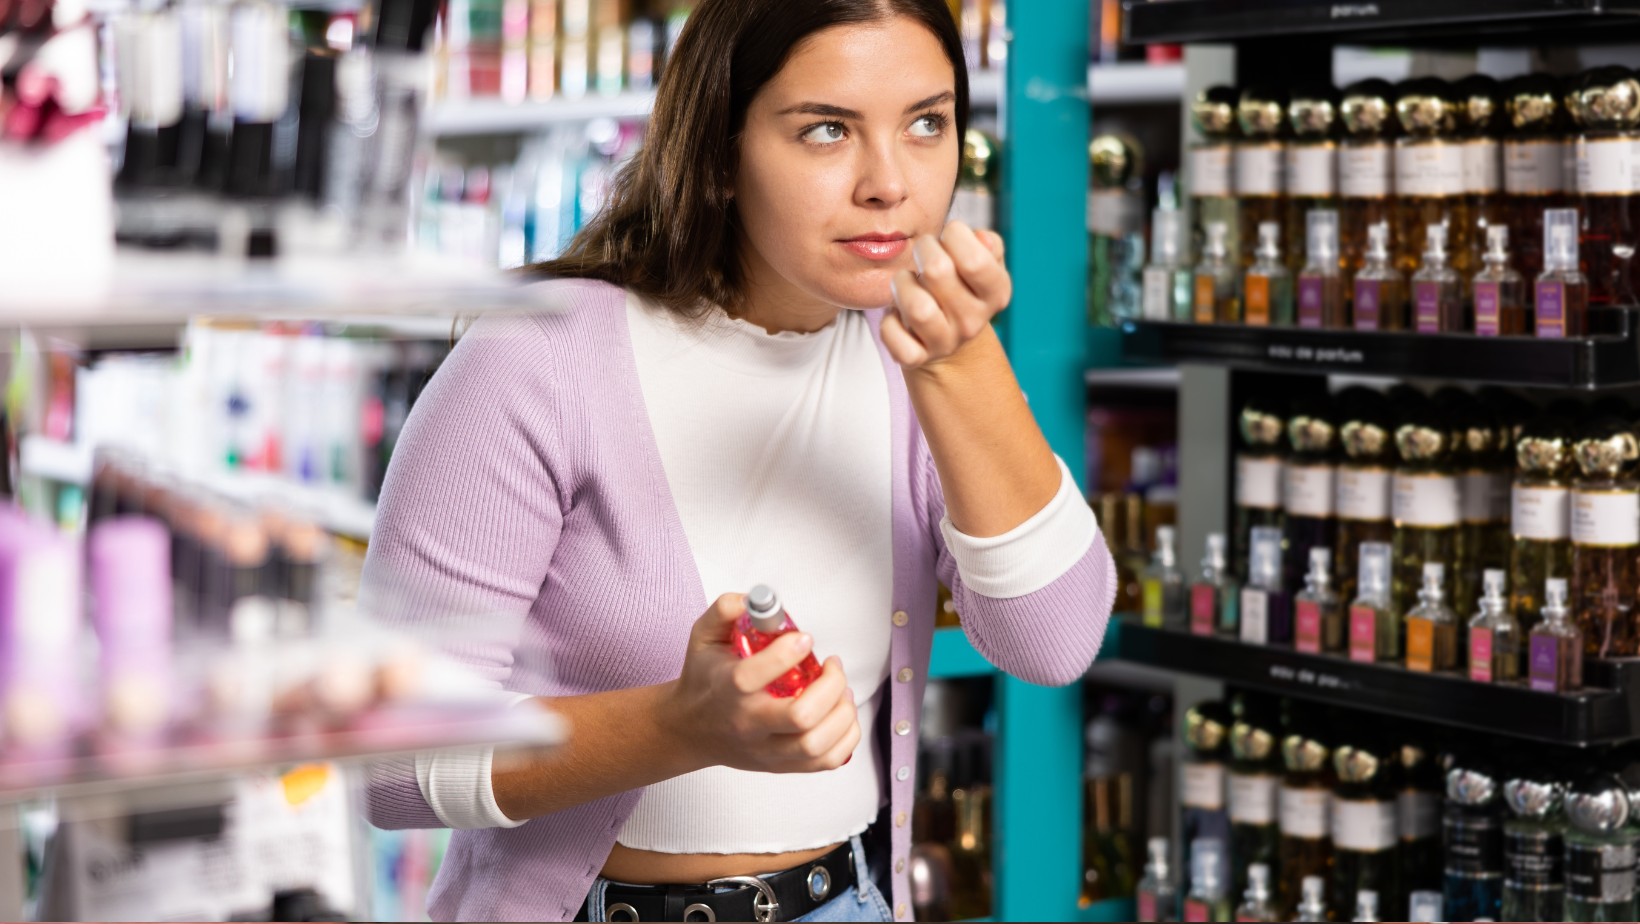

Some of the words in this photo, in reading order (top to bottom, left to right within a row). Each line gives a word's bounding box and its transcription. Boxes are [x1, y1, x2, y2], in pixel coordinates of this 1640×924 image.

[1268, 345, 1292, 358] eau
[1296, 345, 1313, 359] de
[1316, 347, 1363, 362] parfum
[1298, 668, 1315, 683] de
